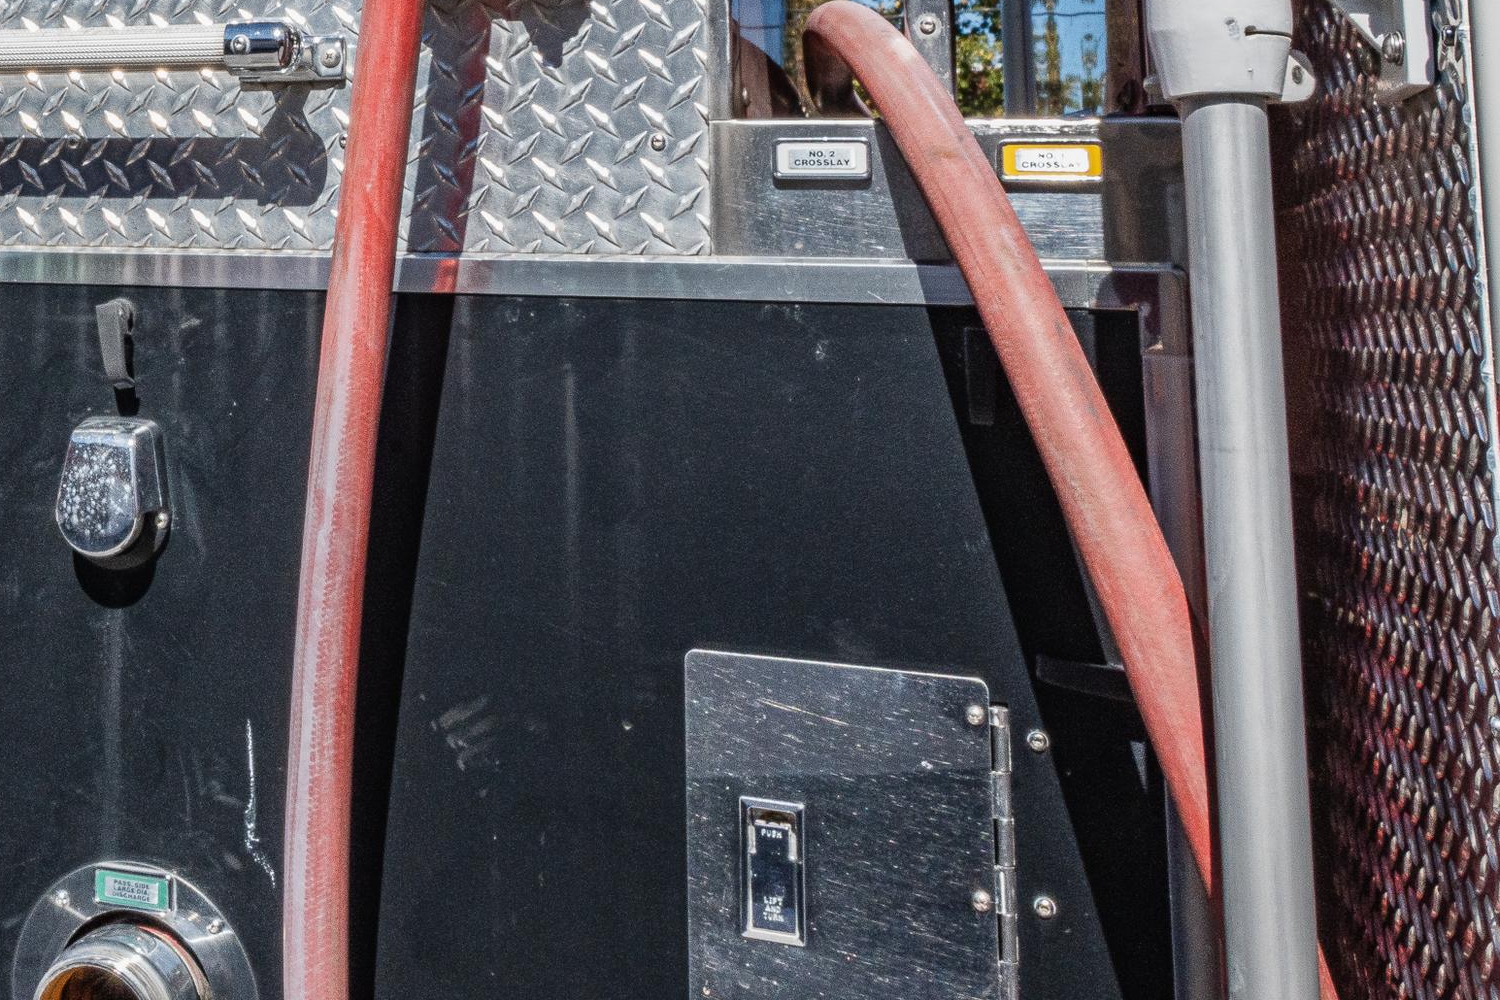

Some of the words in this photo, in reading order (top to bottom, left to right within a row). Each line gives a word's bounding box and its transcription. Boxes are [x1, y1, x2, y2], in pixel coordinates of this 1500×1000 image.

[809, 150, 826, 158] NO.
[829, 150, 835, 158] 2
[761, 828, 782, 839] PUSH
[113, 885, 135, 893] LARGE
[134, 882, 150, 890] SIDE
[112, 891, 151, 902] DISCHARGE
[763, 896, 783, 906] LIFT
[764, 904, 782, 914] AND
[762, 912, 784, 922] TURN
